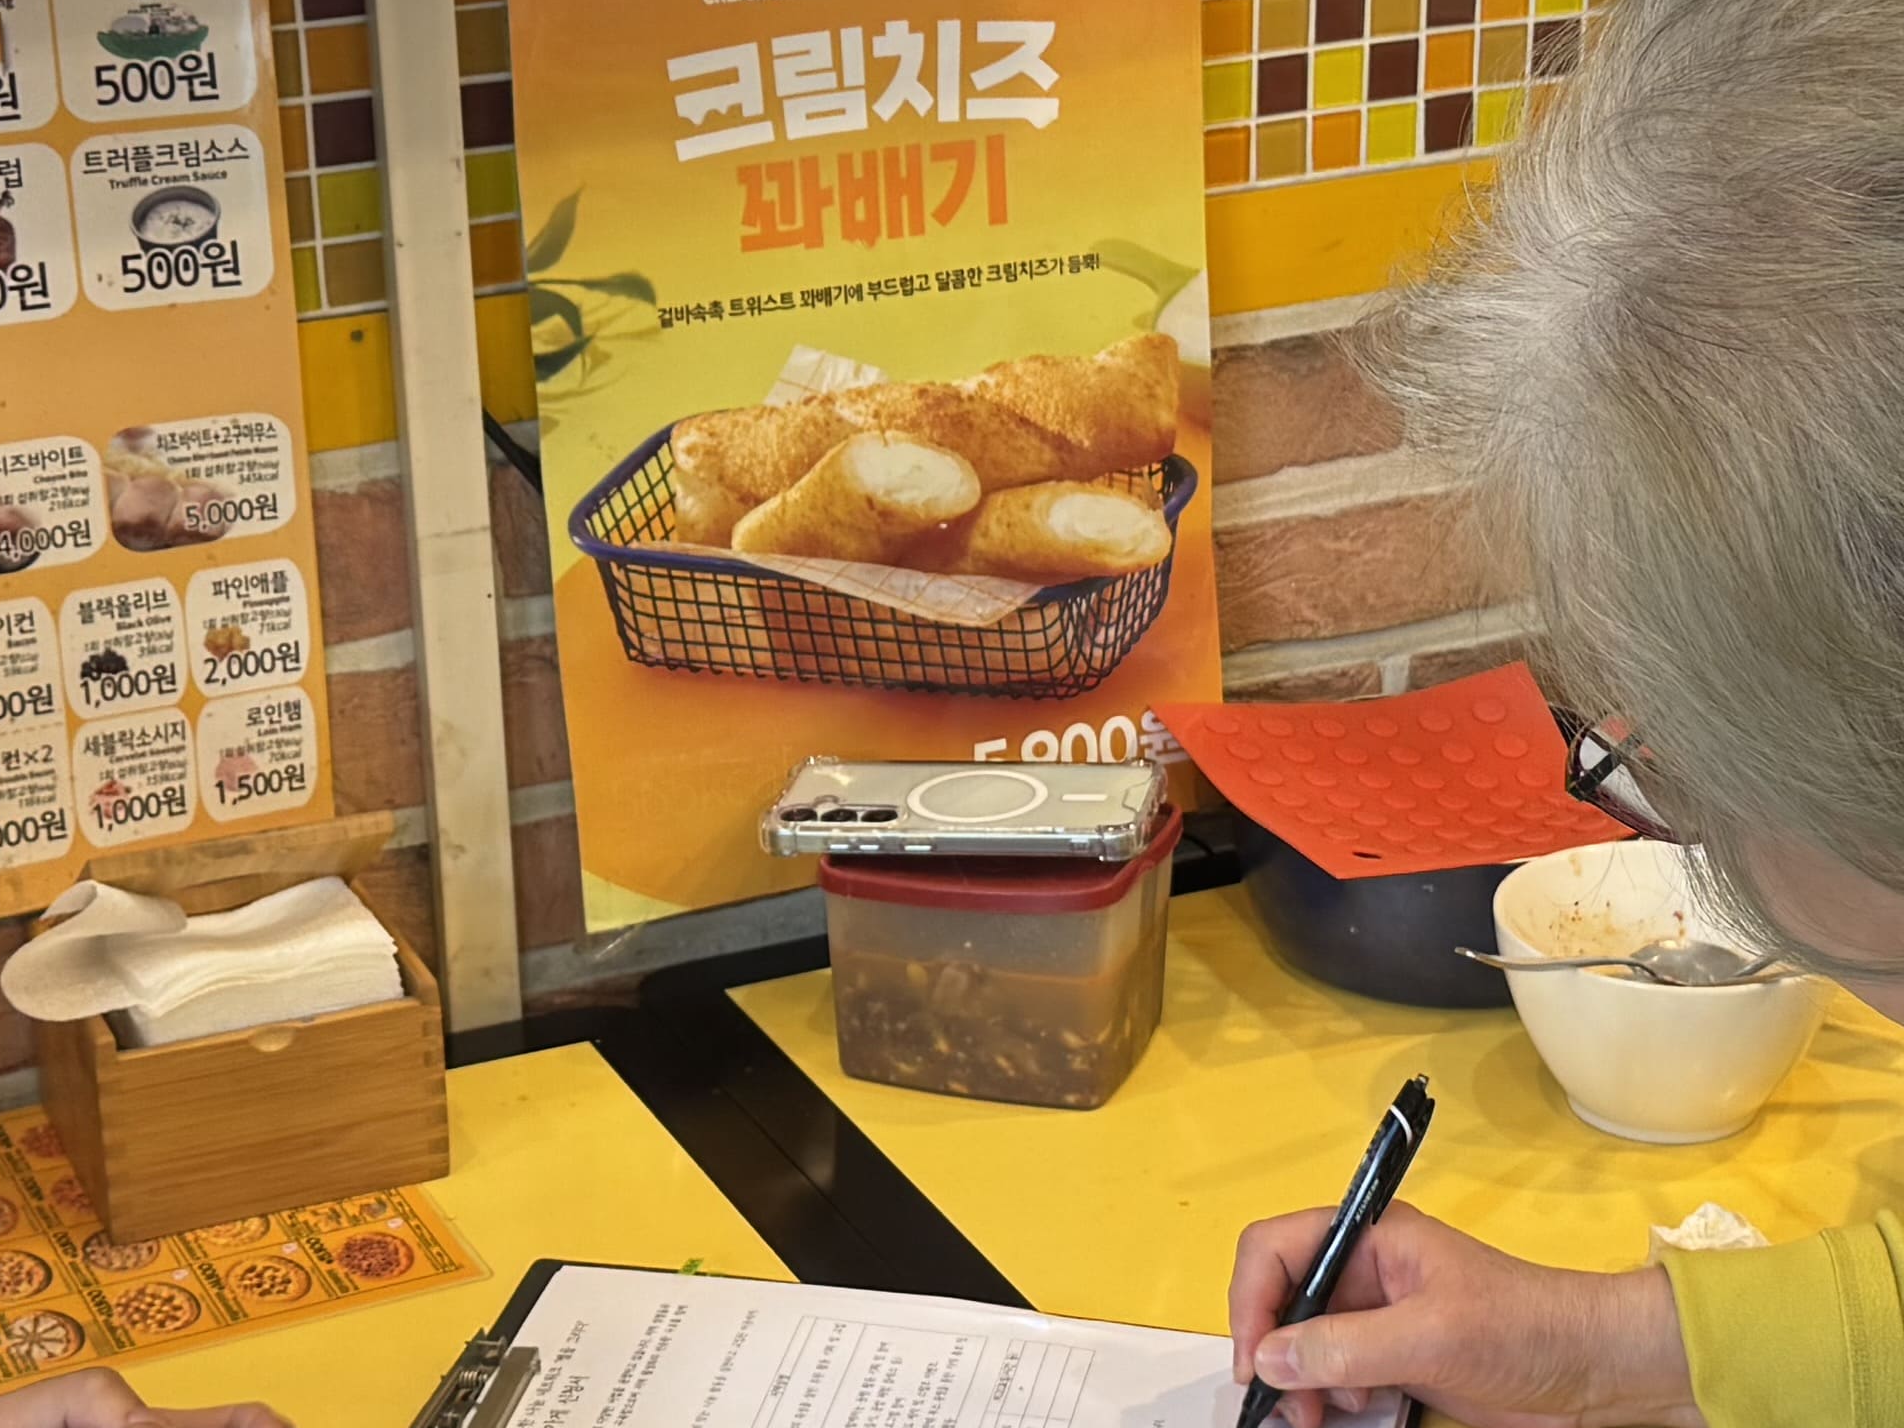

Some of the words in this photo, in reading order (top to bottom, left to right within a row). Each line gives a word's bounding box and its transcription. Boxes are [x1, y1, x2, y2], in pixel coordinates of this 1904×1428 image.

[95, 52, 219, 106] 500원
[667, 20, 1060, 161] 크림치즈
[83, 137, 250, 174] 트러플크림소스
[735, 134, 1008, 253] 꽈배기
[121, 241, 242, 293] 500원
[657, 301, 724, 328] 겉바속촉
[729, 291, 795, 317] 트위스트
[799, 283, 863, 309] 꽈배기에
[867, 274, 931, 302] 부드럽고
[936, 267, 982, 291] 달콤한
[986, 257, 1064, 283] 크림치즈가
[204, 642, 302, 685] 2,000원
[216, 763, 306, 806] 1,500원
